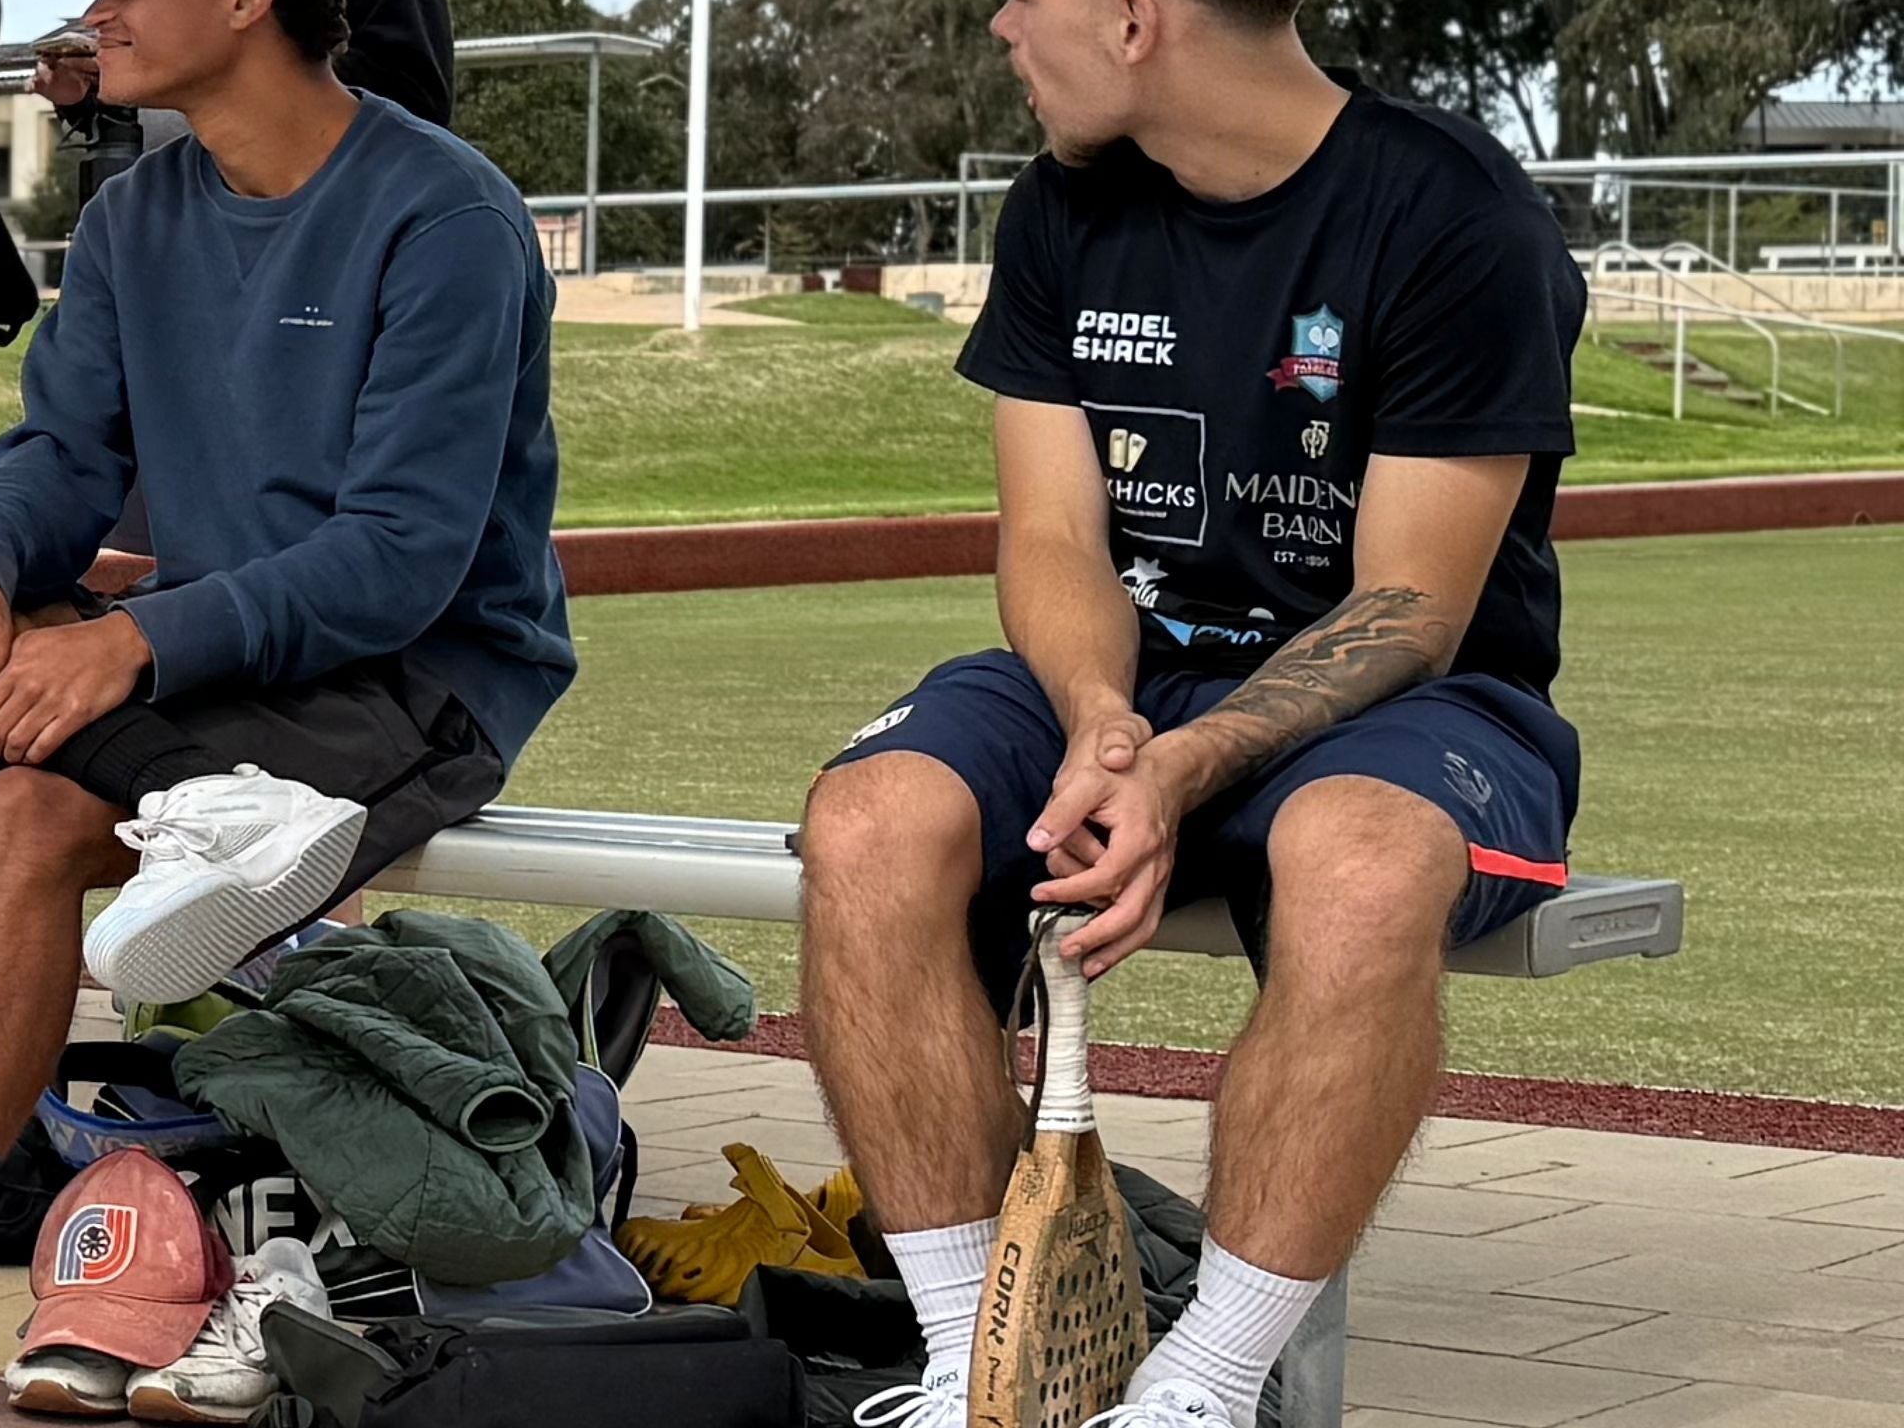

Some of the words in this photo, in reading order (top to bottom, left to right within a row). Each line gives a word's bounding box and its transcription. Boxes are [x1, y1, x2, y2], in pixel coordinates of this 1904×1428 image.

[1076, 309, 1177, 339] PADEL
[1072, 336, 1177, 366] SHACK
[1224, 471, 1359, 510] MAIDEN
[1261, 512, 1343, 545] BARN
[212, 1175, 357, 1256] NEX
[988, 1240, 1023, 1347] CORK
